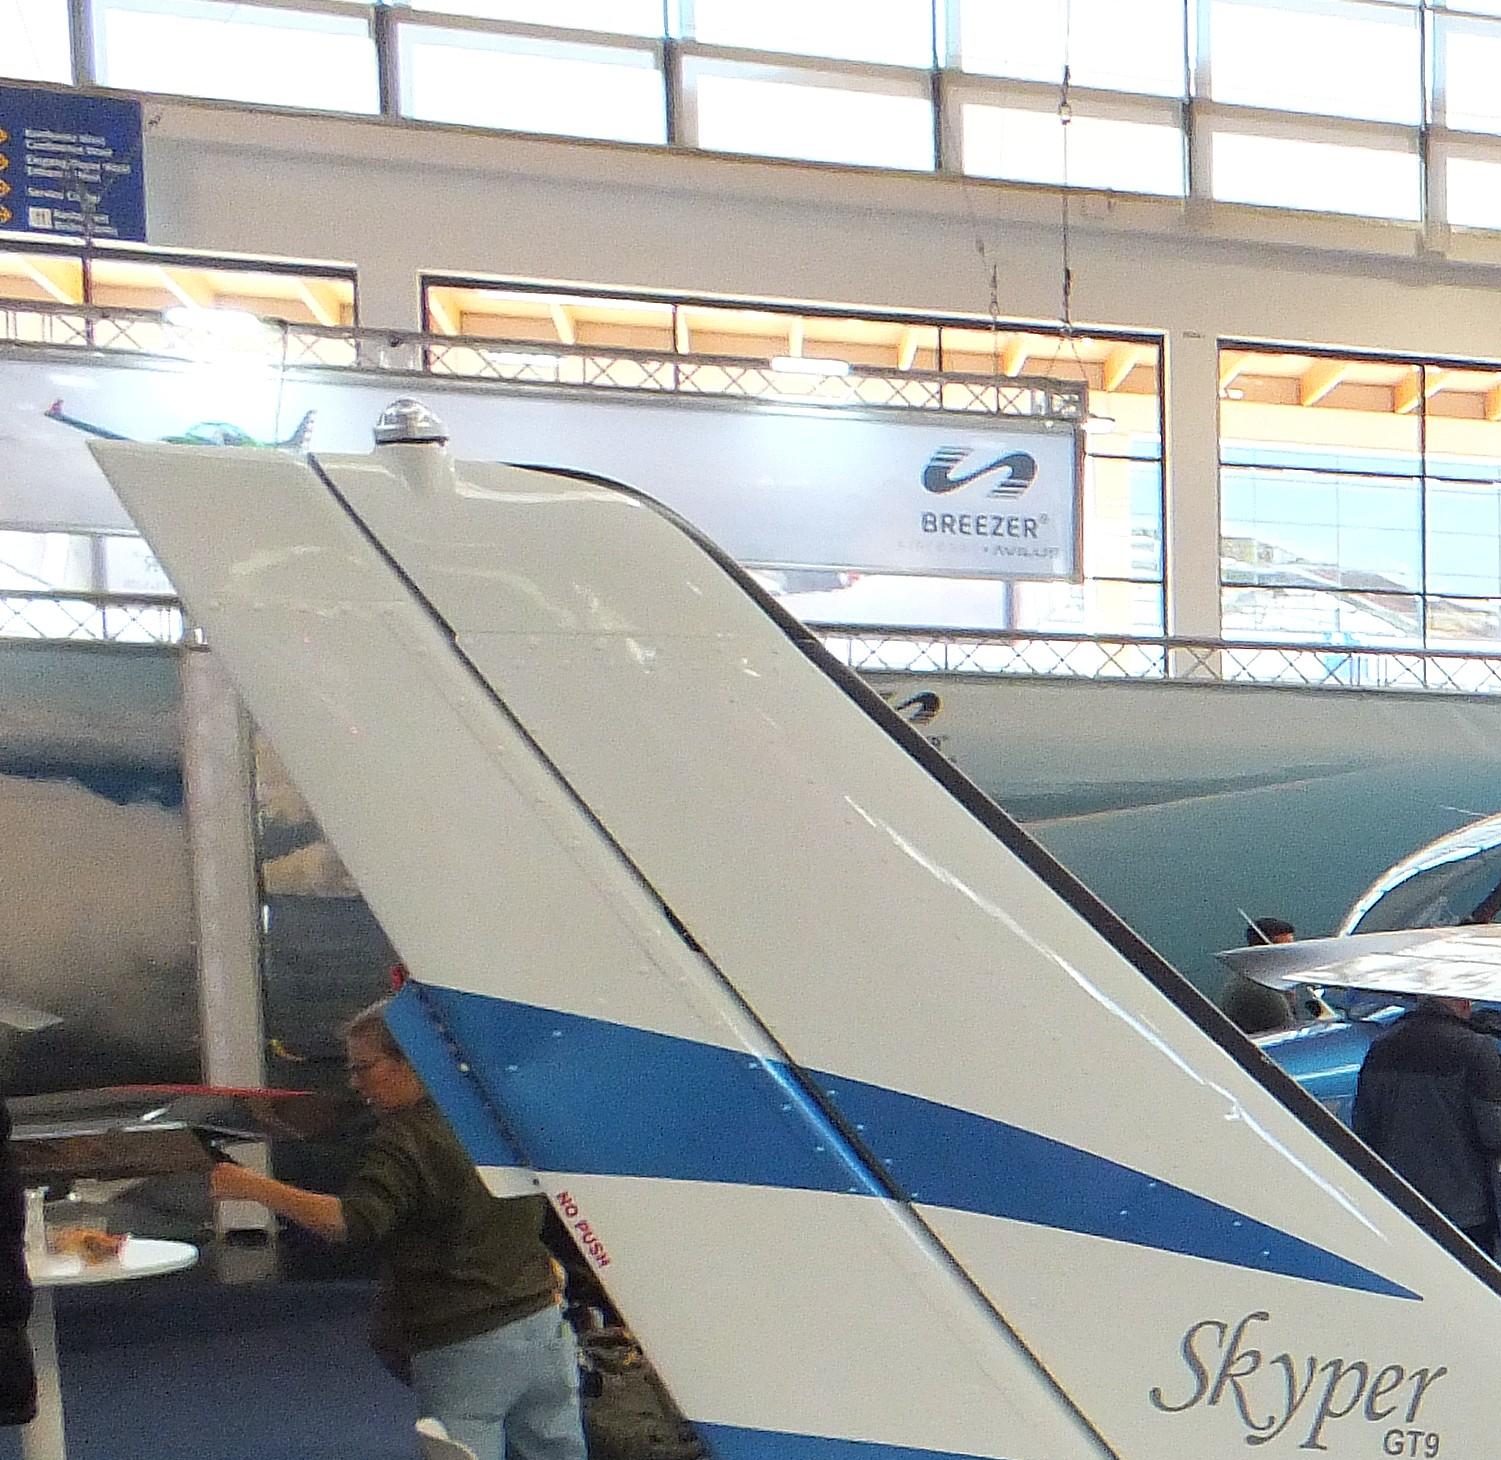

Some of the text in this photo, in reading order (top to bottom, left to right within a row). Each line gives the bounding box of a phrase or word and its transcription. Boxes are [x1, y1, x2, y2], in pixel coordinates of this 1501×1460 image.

[922, 511, 1037, 539] BREEZER
[557, 1191, 611, 1268] NO PUSH
[1149, 1310, 1448, 1451] Skyper
[1383, 1427, 1441, 1458] GT9
